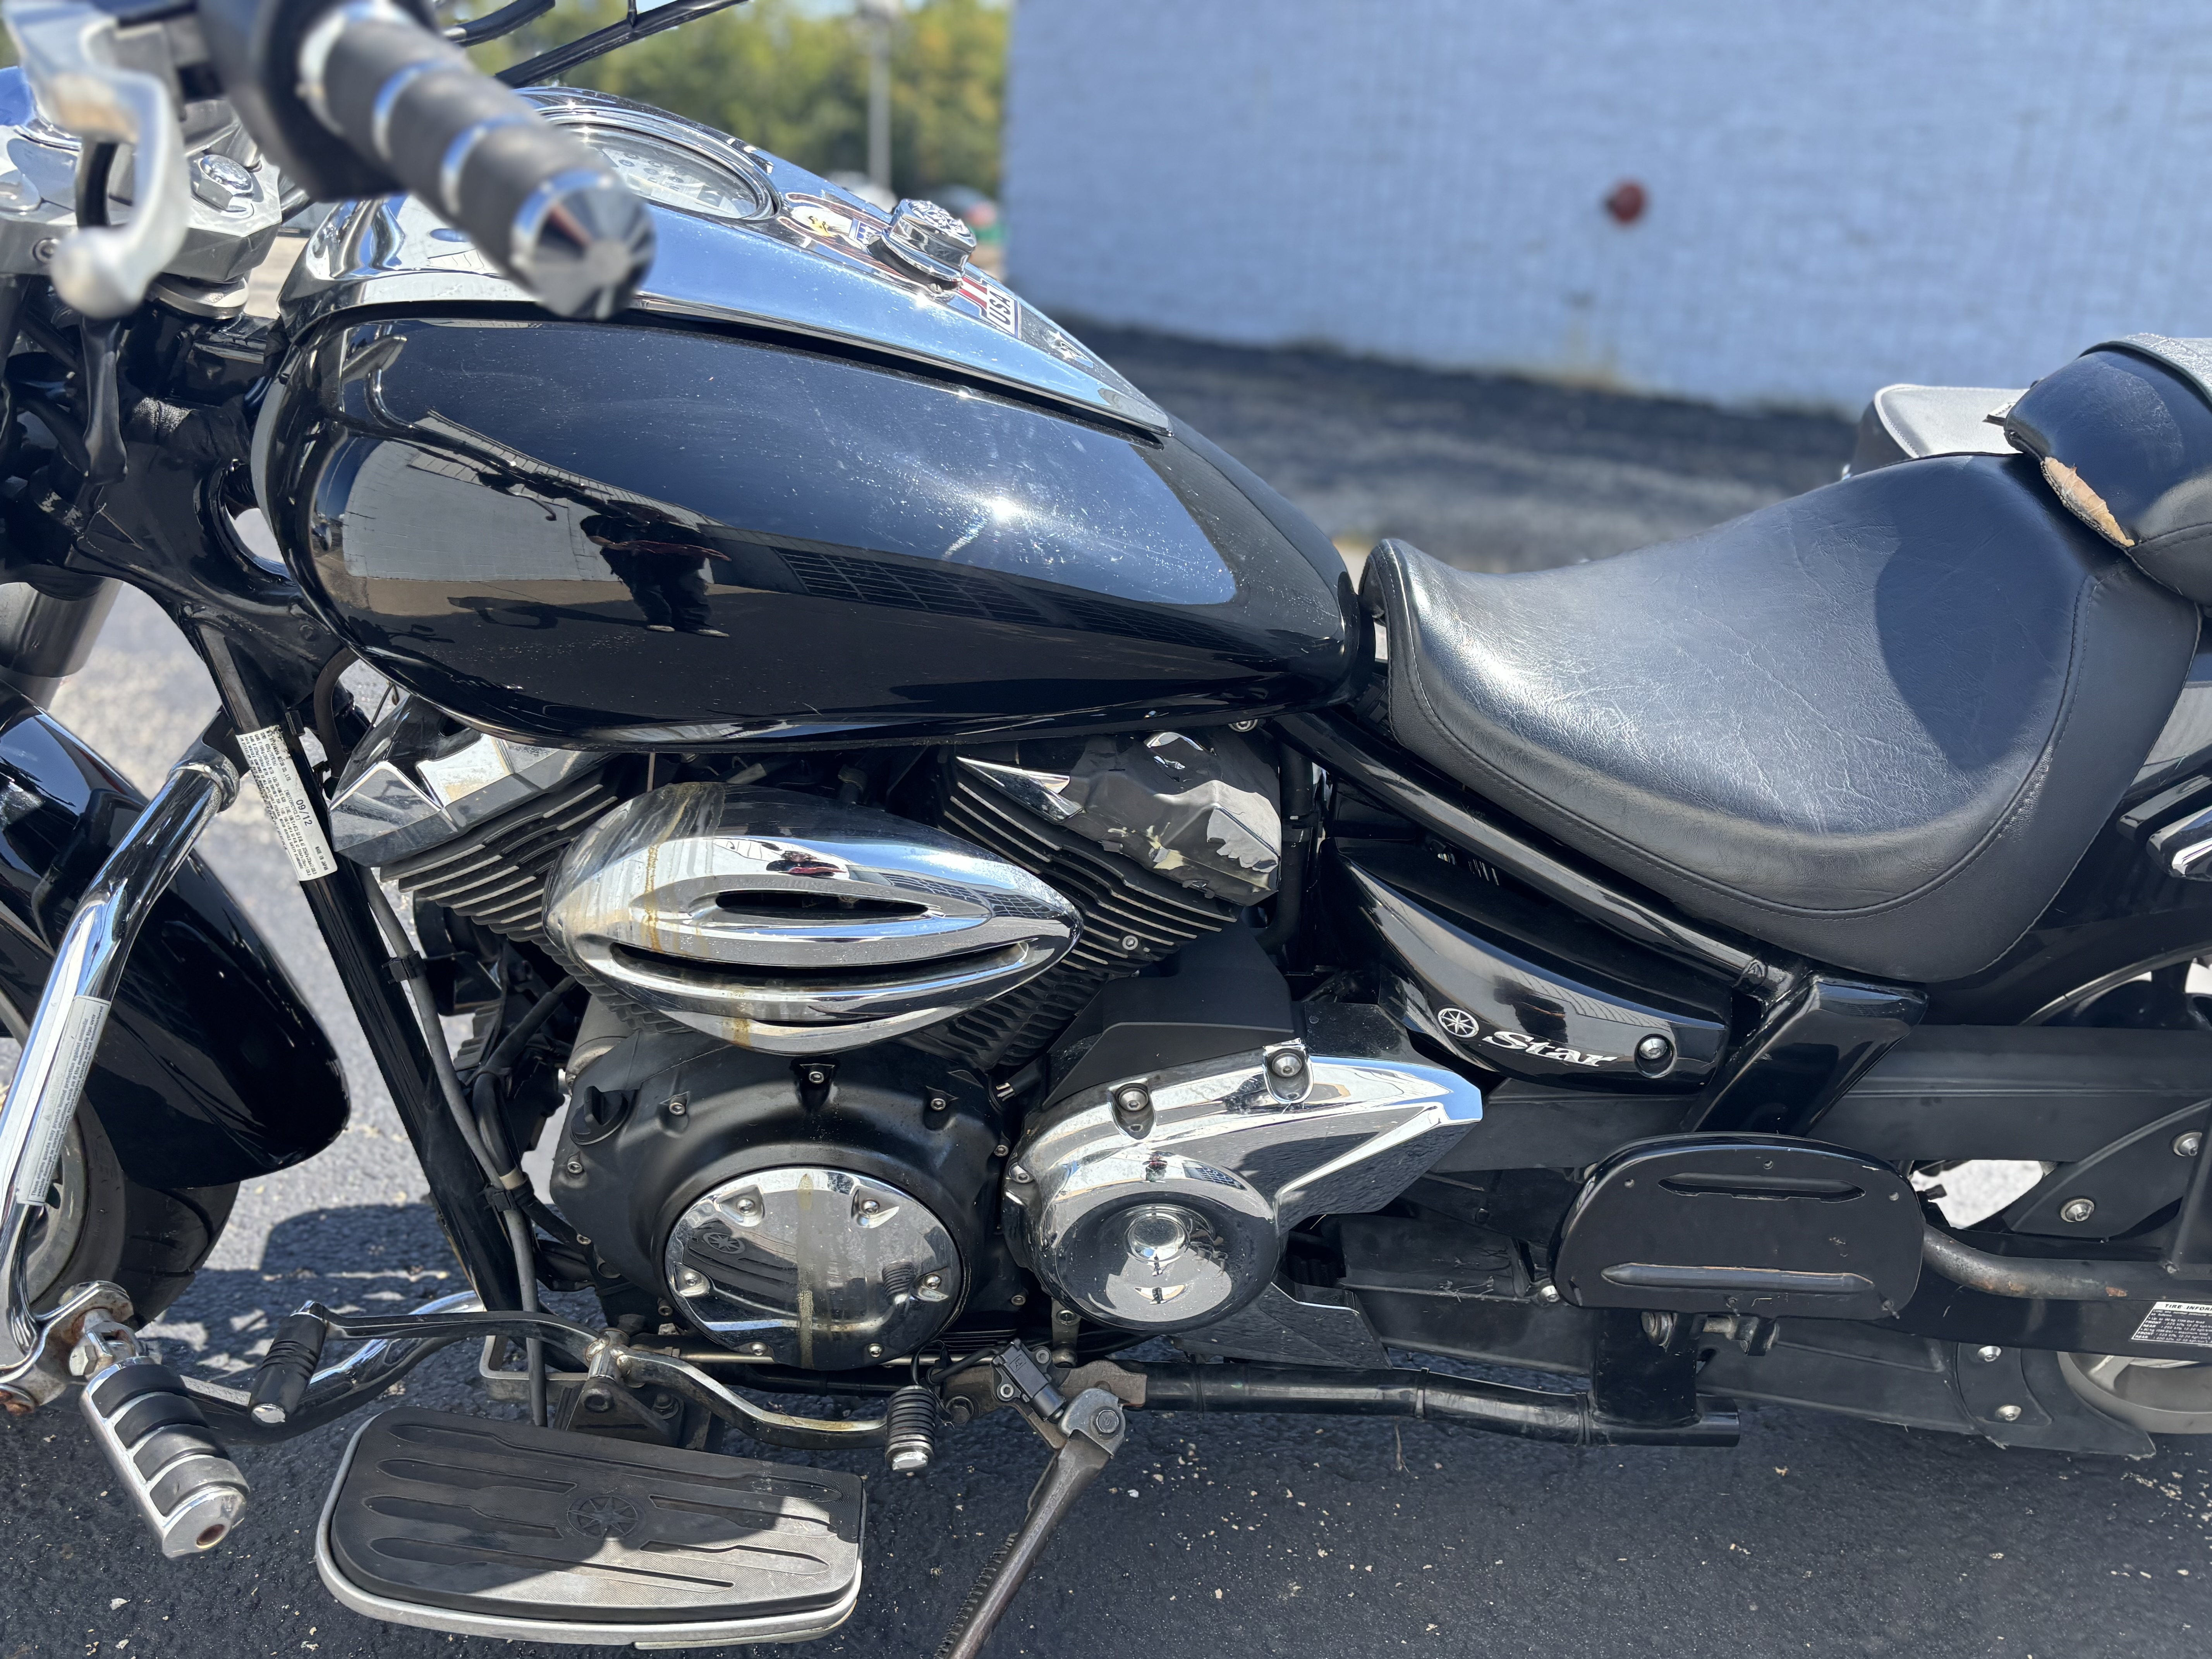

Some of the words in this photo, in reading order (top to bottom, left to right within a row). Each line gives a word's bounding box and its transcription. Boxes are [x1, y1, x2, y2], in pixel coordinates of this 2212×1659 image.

[989, 290, 1011, 325] USA
[294, 799, 313, 826] 09/12
[78, 1036, 90, 1065] motorcycle
[1482, 1031, 1618, 1067] Star
[31, 1180, 40, 1196] These
[42, 1142, 52, 1160] guards
[52, 1108, 62, 1128] provide
[58, 1089, 67, 1108] limited
[64, 1062, 76, 1088] protection
[73, 1042, 82, 1061] against
